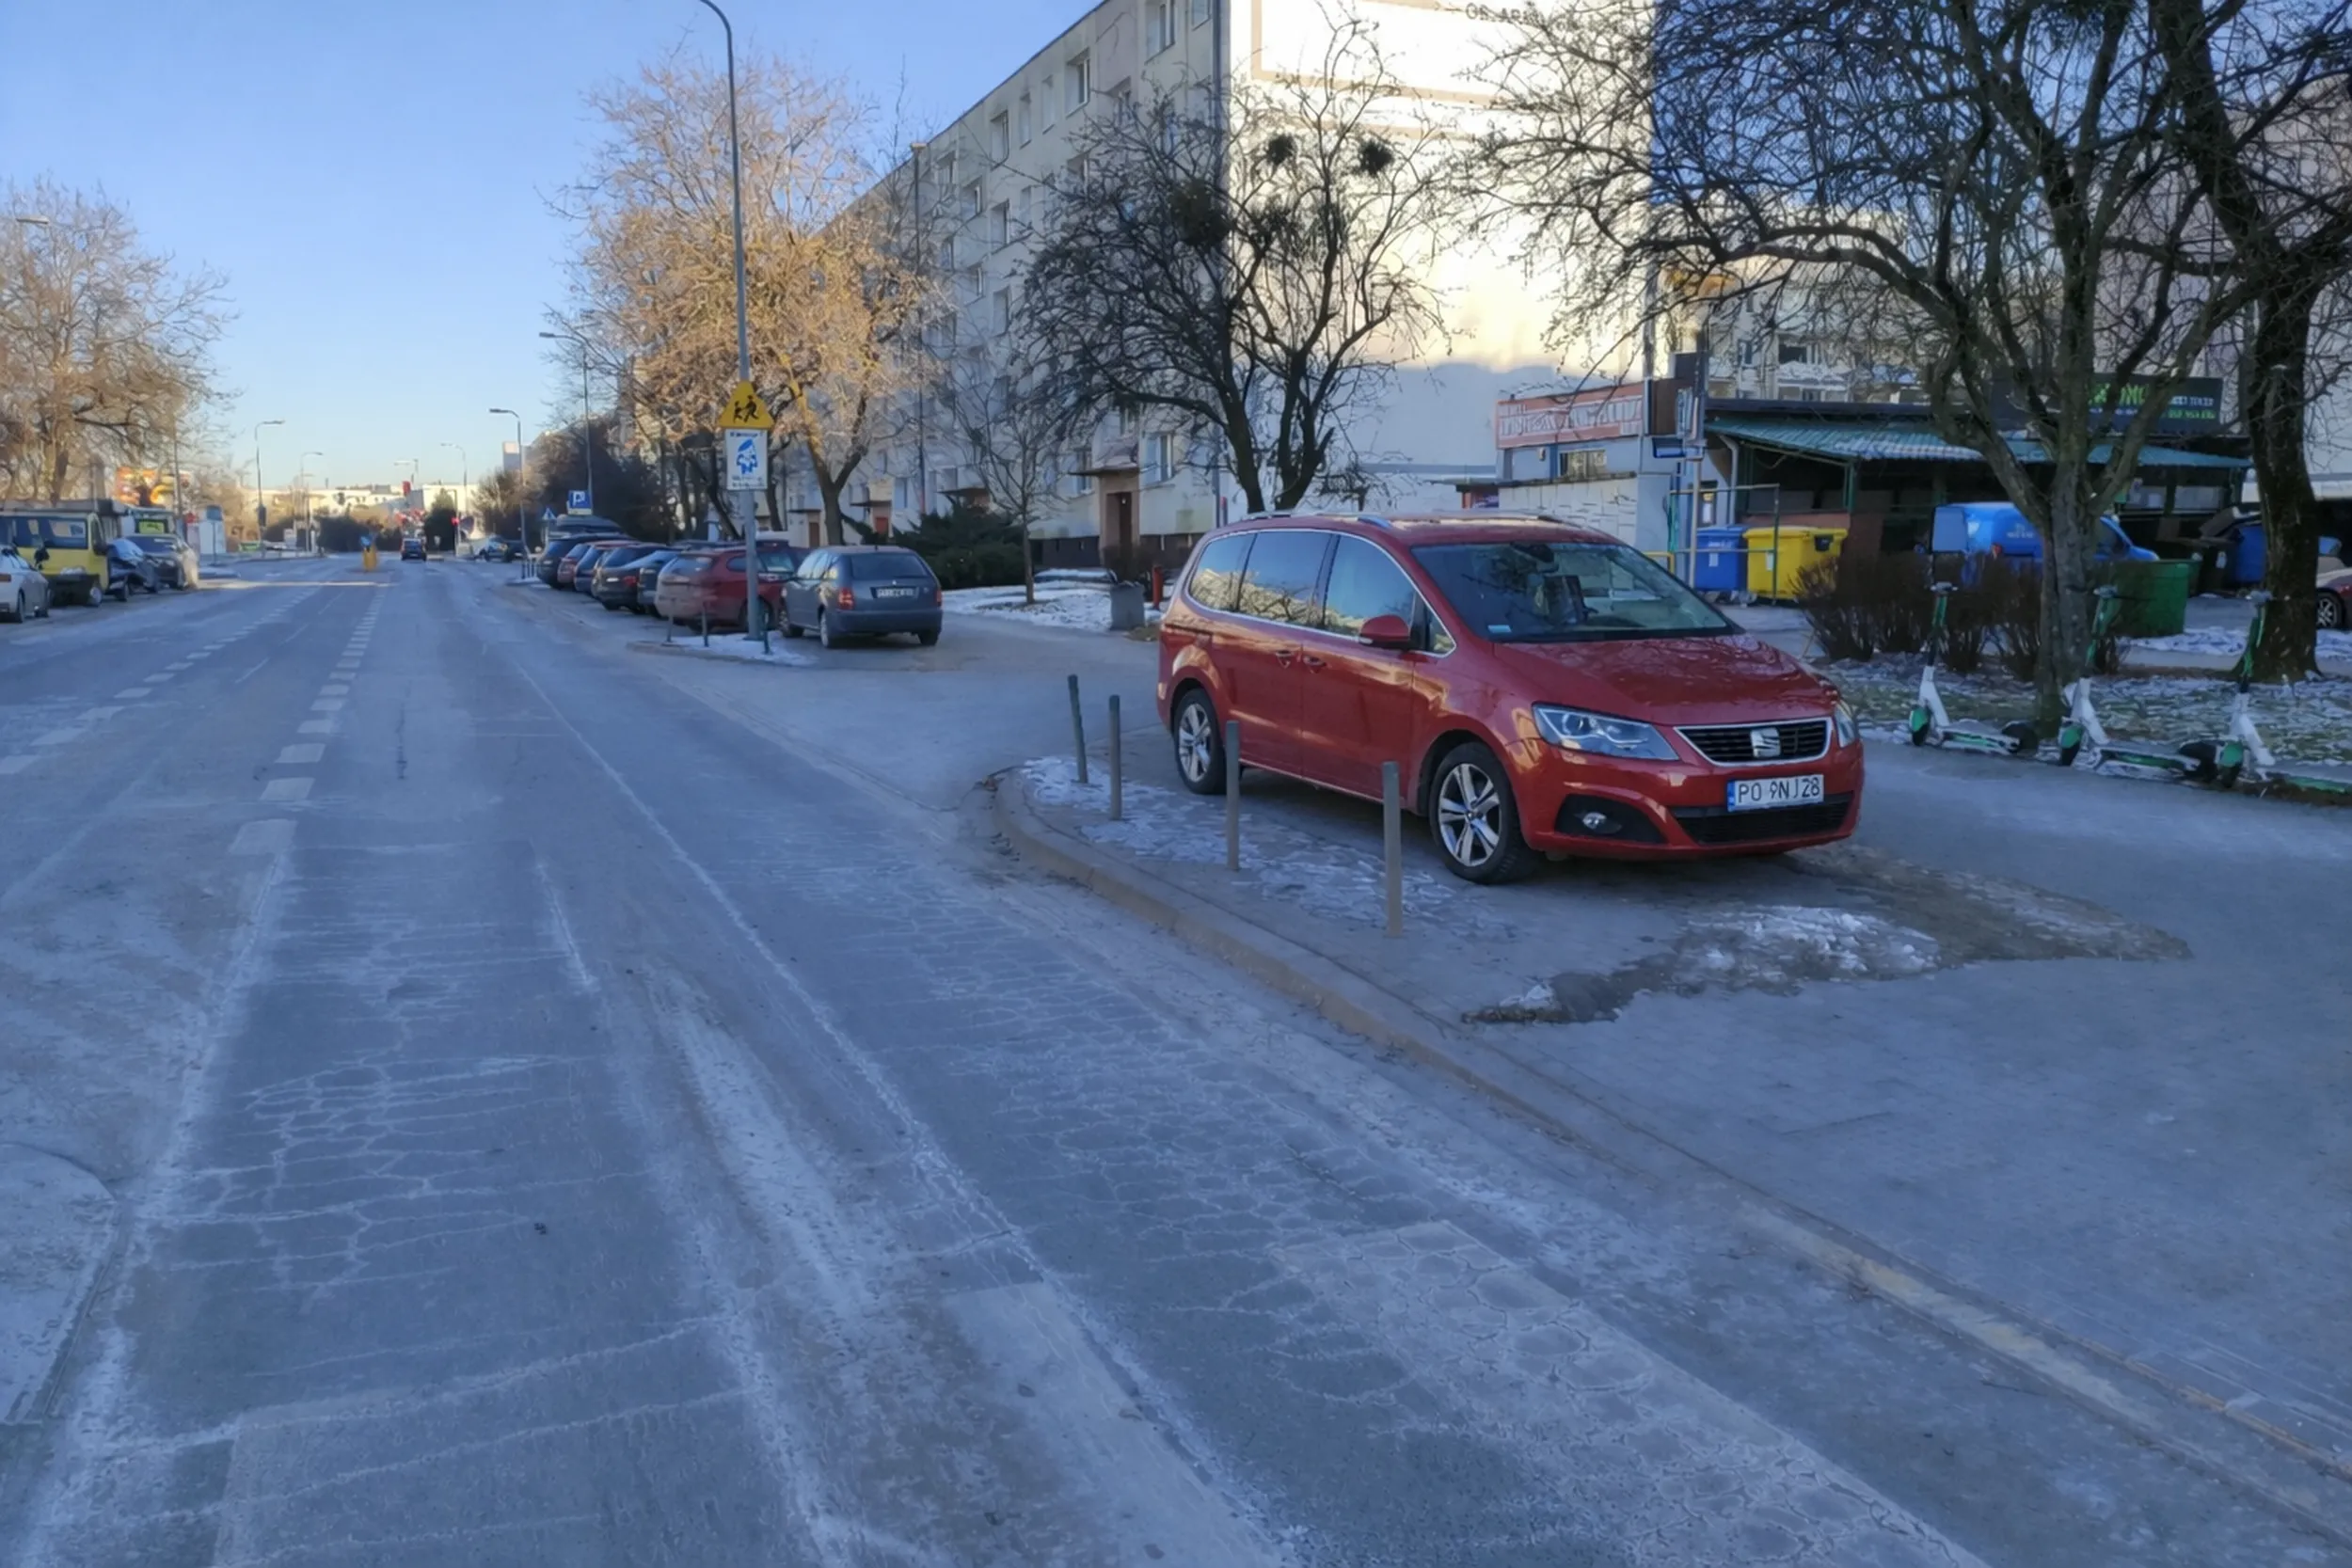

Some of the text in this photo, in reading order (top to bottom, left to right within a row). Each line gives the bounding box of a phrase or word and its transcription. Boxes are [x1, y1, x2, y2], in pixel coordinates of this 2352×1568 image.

[573, 491, 585, 506] P
[1738, 777, 1820, 803] PO 9NJ28
